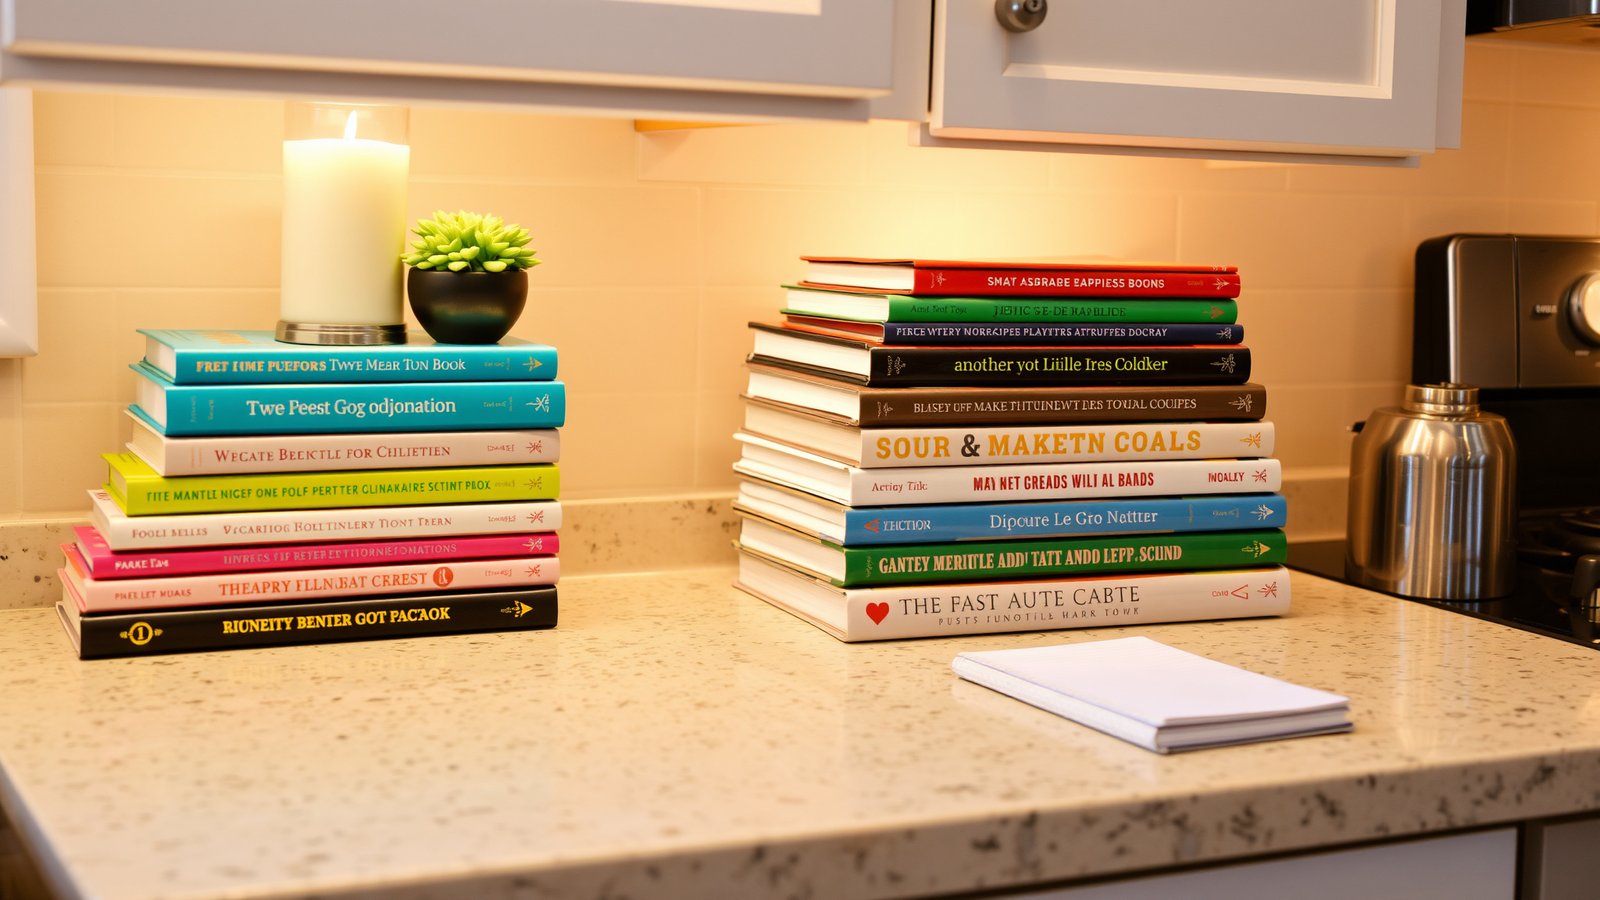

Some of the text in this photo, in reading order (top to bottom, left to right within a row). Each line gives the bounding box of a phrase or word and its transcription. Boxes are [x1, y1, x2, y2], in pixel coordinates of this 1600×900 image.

[1128, 278, 1165, 289] BOONS
[1128, 328, 1168, 337] DOCRAY
[954, 357, 1014, 372] another
[1016, 358, 1039, 376] yot
[1114, 356, 1169, 371] Coldker
[246, 397, 457, 418] Twe Peest Gog odjonation
[974, 401, 1008, 413] MAKE
[346, 447, 373, 459] FOR
[876, 429, 1201, 460] SOUR & MAKETN COALS
[1000, 475, 1021, 491] NET
[1024, 474, 1068, 490] GREADS
[256, 487, 278, 499] ONE
[1054, 512, 1072, 527] Le
[1075, 510, 1103, 526] Gro
[878, 555, 931, 574] GANTEY
[1065, 548, 1101, 566] ANDO
[218, 579, 292, 597] THEAPRY
[899, 597, 942, 616] THE
[951, 593, 999, 613] FAST
[1008, 590, 1065, 610] AUTE
[297, 613, 352, 630] BENTER
[354, 610, 387, 627] GOT
[137, 626, 145, 640] 1
